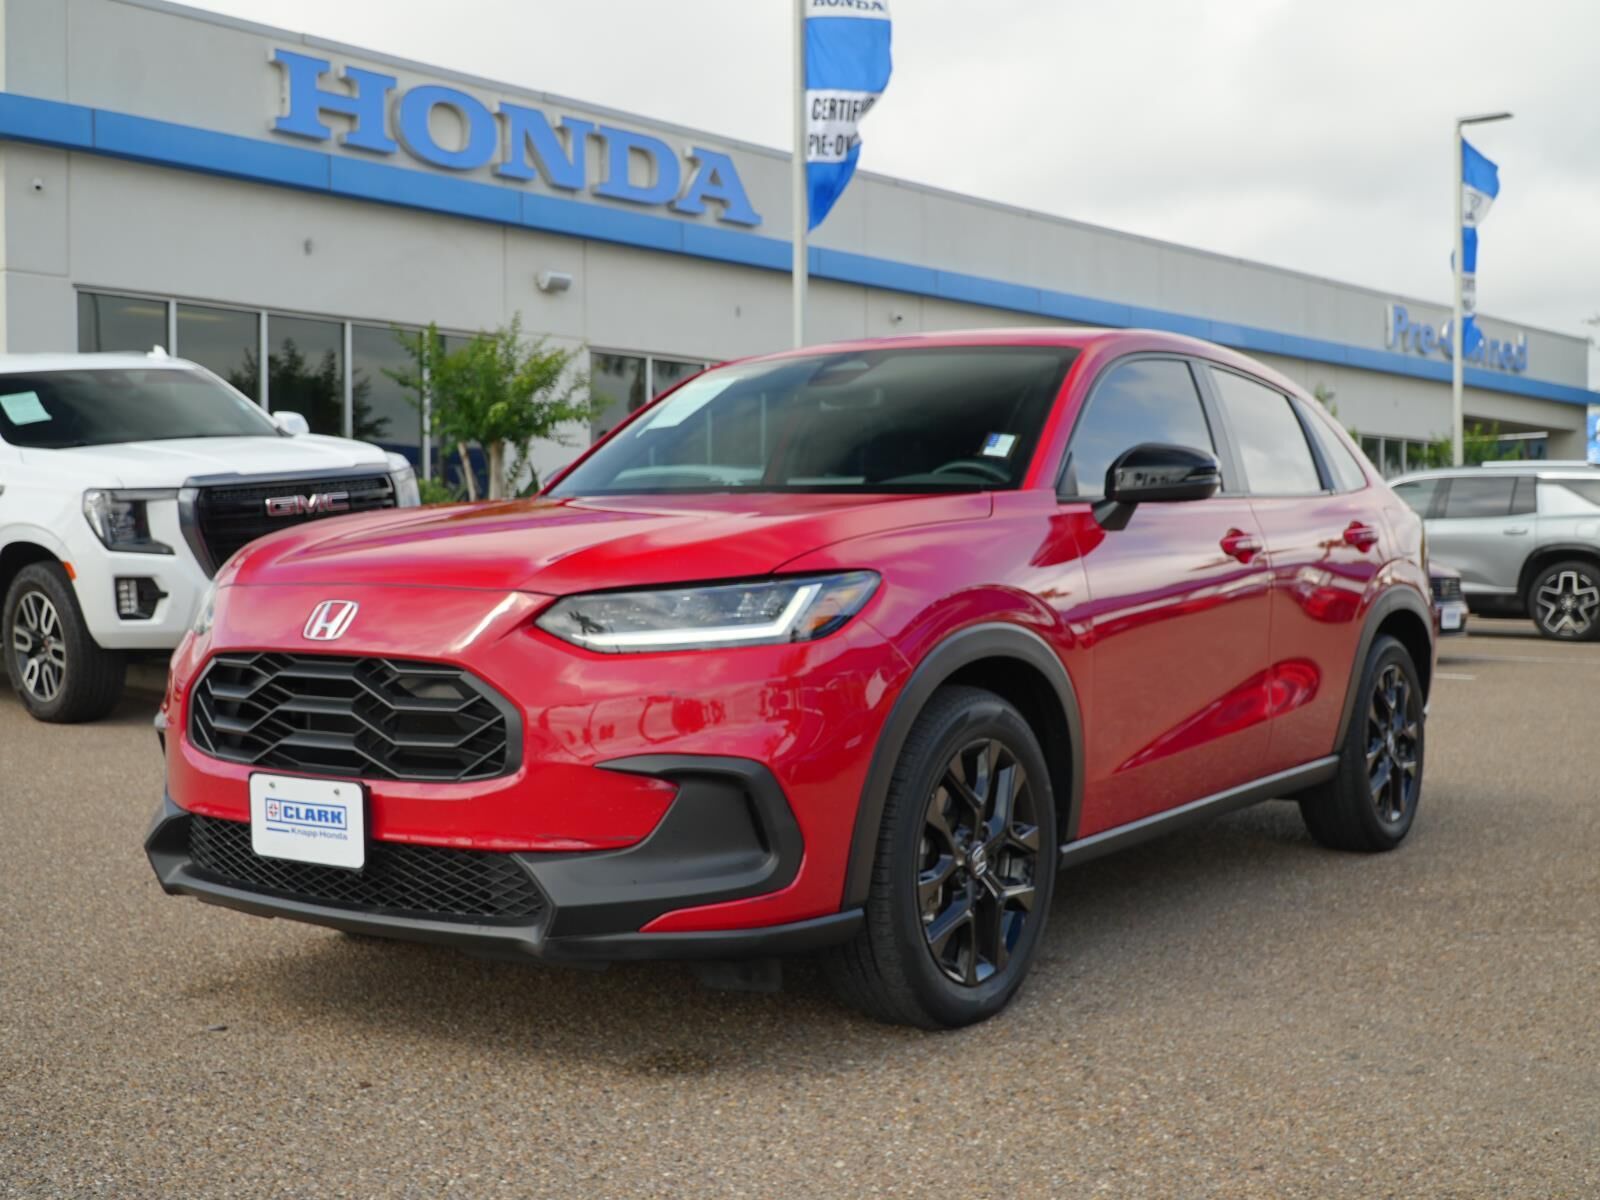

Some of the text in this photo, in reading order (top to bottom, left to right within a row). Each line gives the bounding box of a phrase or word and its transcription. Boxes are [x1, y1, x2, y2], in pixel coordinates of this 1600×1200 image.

[270, 48, 763, 227] HONDA
[265, 491, 349, 516] GMC
[283, 804, 343, 824] CLARK
[290, 826, 348, 840] Knapp Honda
